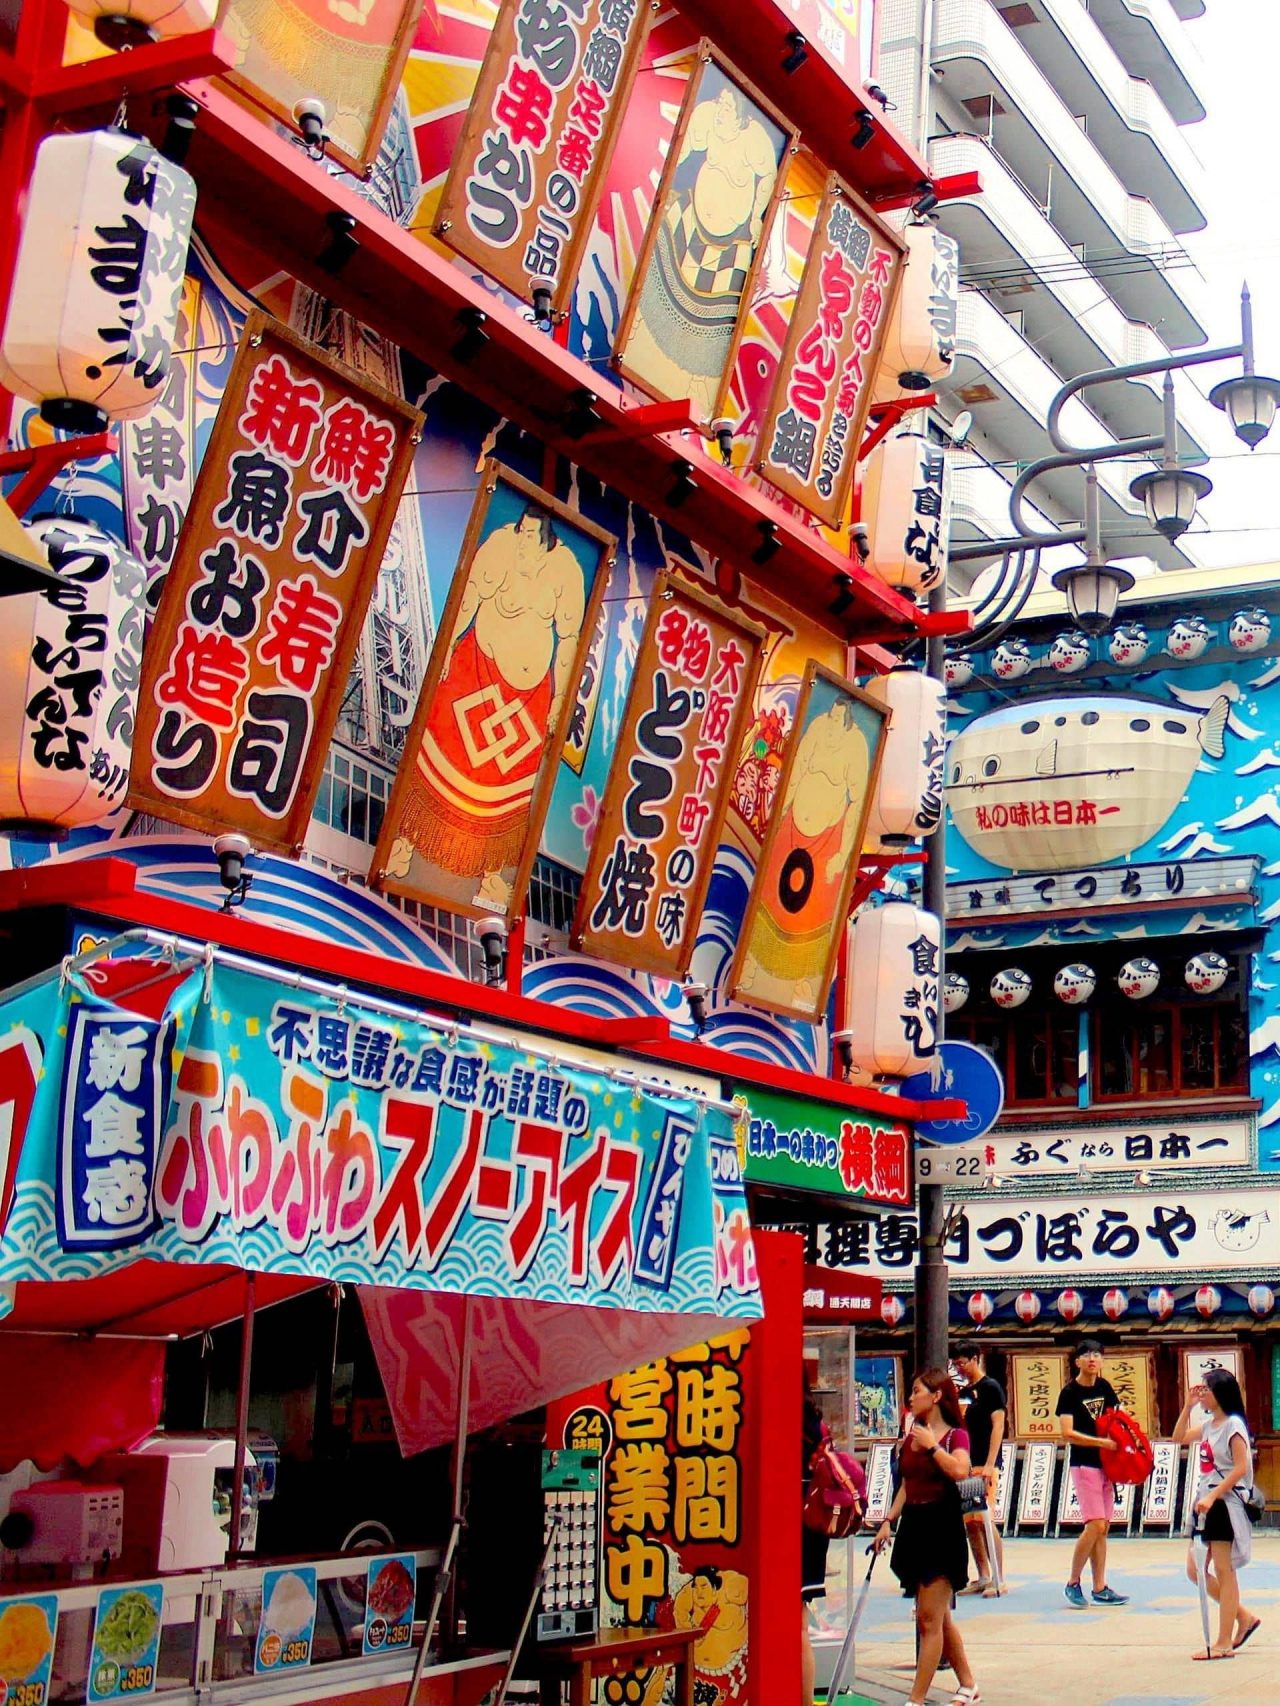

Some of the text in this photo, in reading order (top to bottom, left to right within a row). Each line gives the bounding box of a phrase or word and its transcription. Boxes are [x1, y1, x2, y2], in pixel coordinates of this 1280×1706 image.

[827, 201, 872, 272] 横綱
[770, 250, 855, 483] ちゃんこ鍋
[237, 355, 396, 500] 新鮮
[220, 575, 343, 819] 寿司
[656, 608, 713, 682] 名物
[655, 638, 747, 949] 大阪下町の味
[269, 1004, 590, 1134] 不思議な食感が話題の
[82, 1024, 150, 1227] 新食感
[749, 1119, 839, 1169] 日本一の串かつ
[840, 1121, 908, 1200] 横綱
[571, 1414, 604, 1438] 24
[1028, 1423, 1054, 1434] 840
